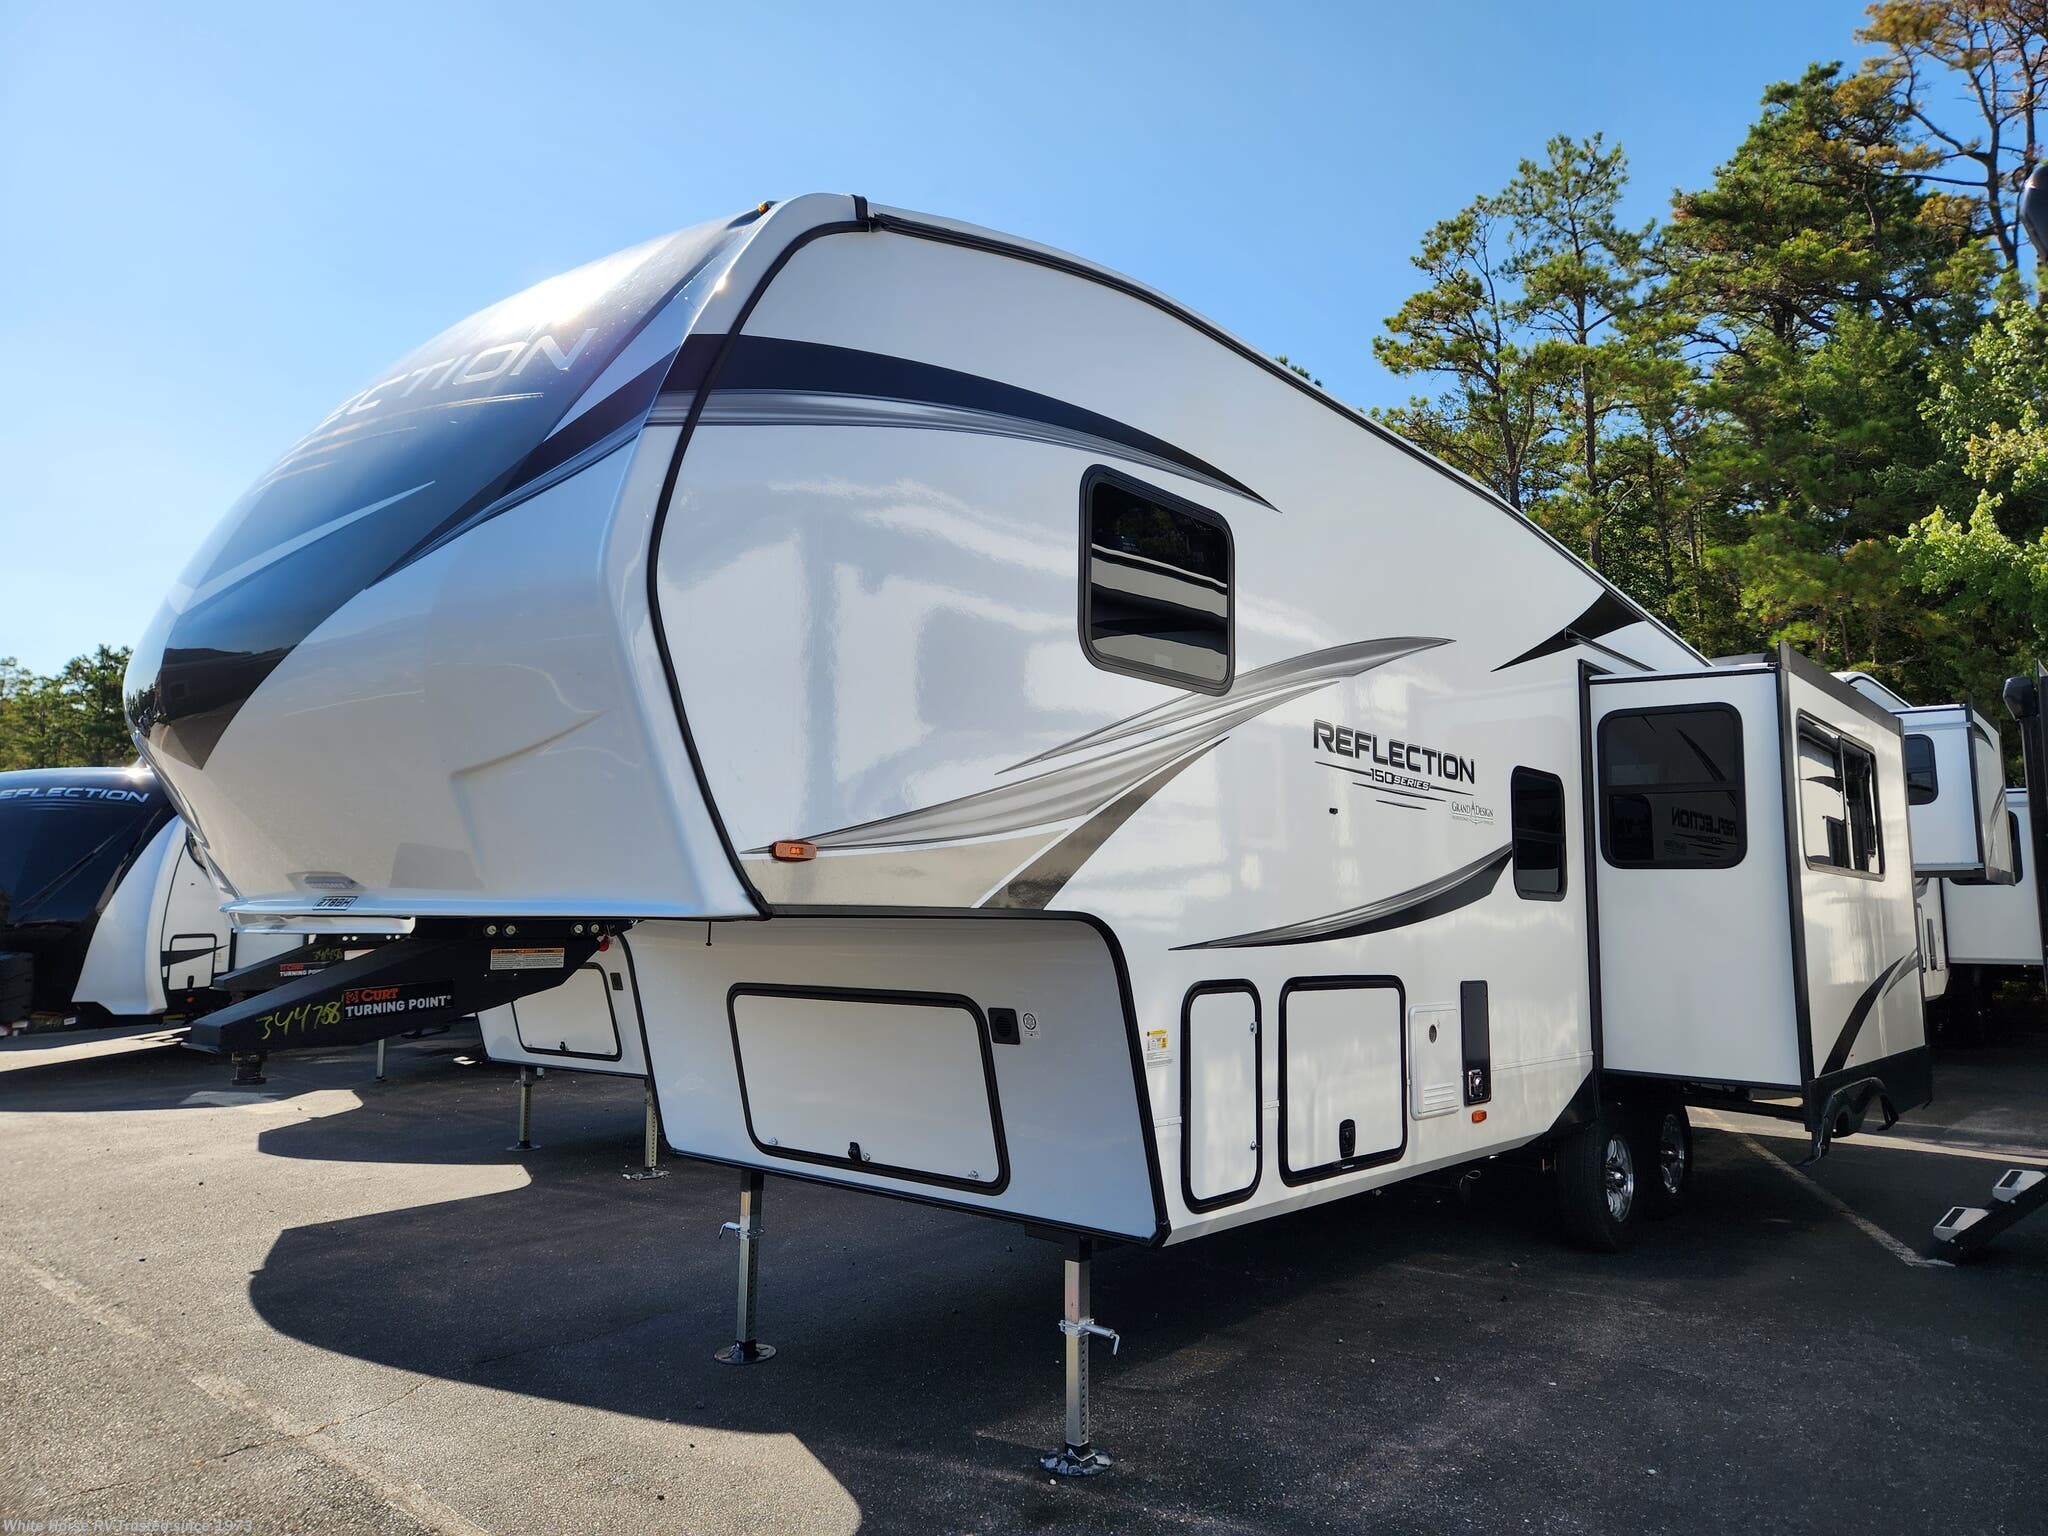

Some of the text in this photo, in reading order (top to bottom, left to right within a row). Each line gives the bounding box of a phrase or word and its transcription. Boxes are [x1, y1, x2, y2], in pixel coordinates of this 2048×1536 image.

[1313, 718, 1476, 785] REFLECTION
[0, 786, 150, 804] EFLECTION
[1451, 801, 1494, 818] GRAND DESIGN
[361, 986, 400, 1003] CURT
[345, 1000, 406, 1018] TURNING
